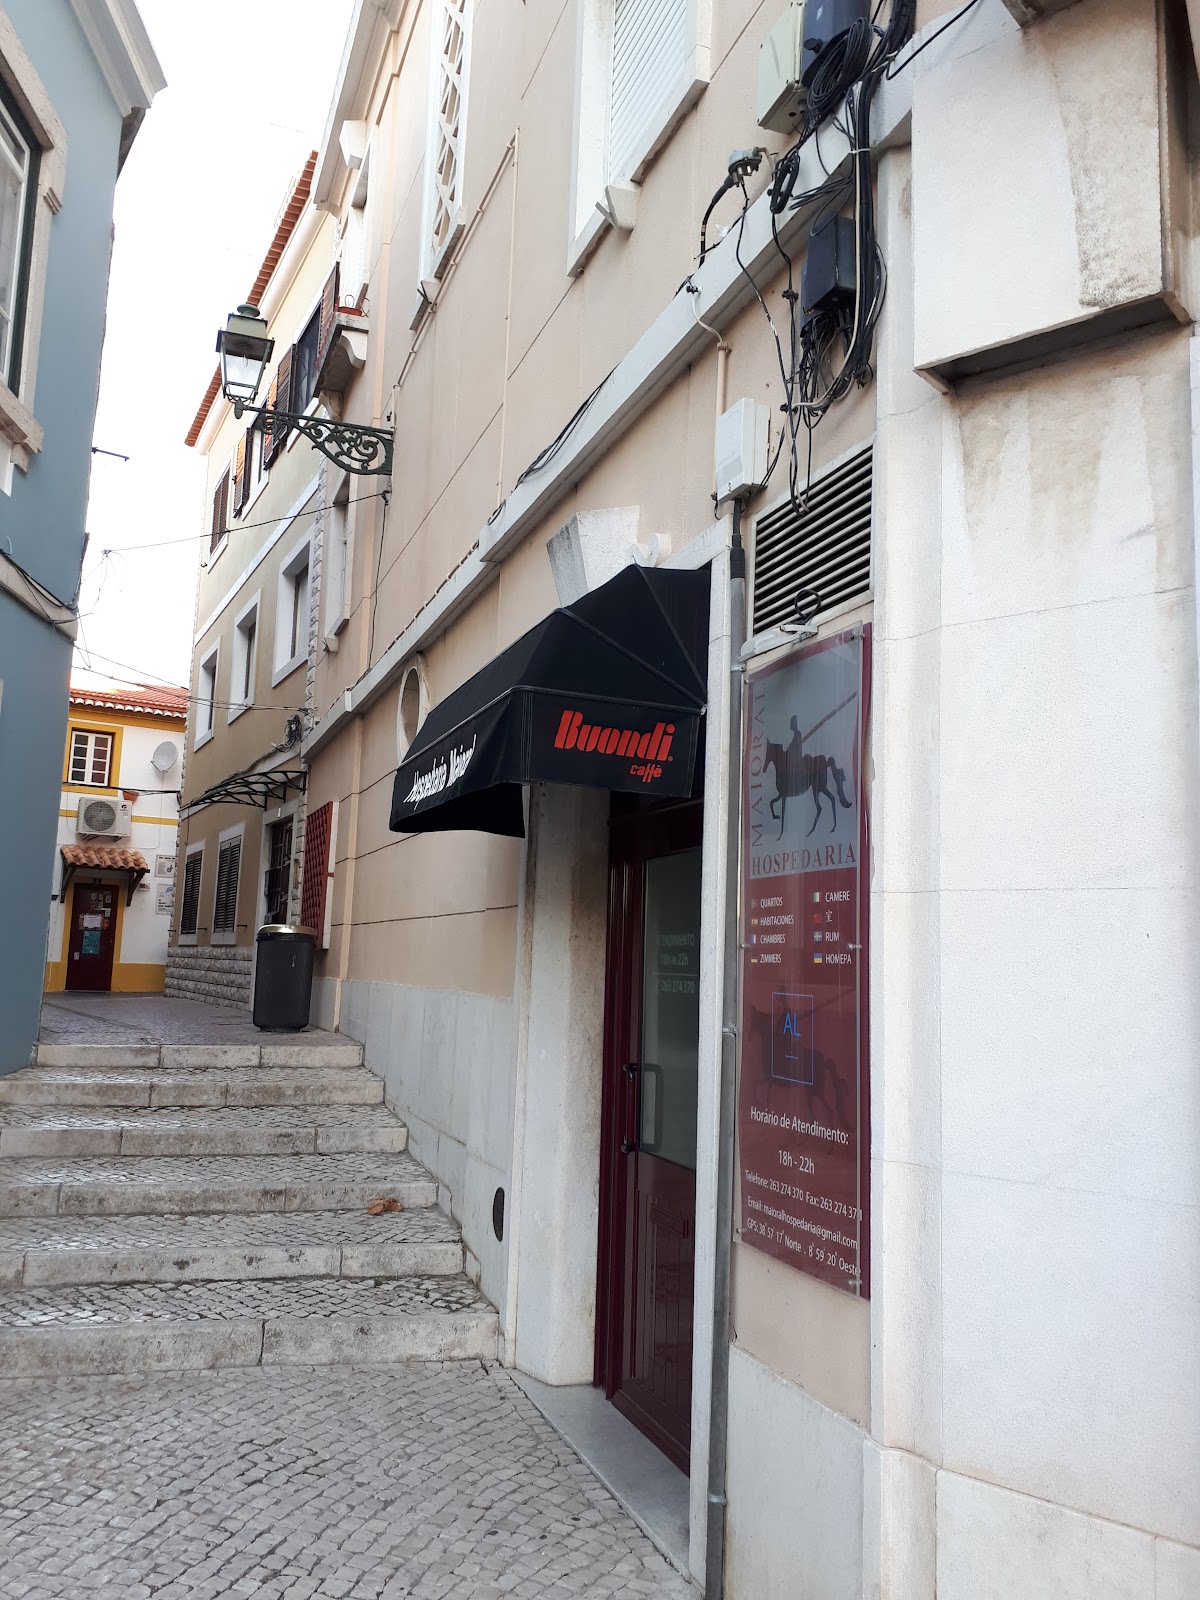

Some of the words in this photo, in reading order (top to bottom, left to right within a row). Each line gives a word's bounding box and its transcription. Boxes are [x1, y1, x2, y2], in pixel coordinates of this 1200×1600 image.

[554, 710, 676, 762] Buondi
[629, 763, 663, 783] caffè
[750, 685, 767, 847] MAIORAL
[752, 842, 857, 876] HOSPEDARIA
[760, 897, 783, 908] QUARTOS
[825, 891, 851, 902] CAMERE
[760, 915, 795, 926] HABITACIONES
[760, 934, 786, 944] CHAMBRES
[825, 931, 840, 942] RUM
[678, 952, 689, 966] 22h
[760, 954, 782, 964] ZIMMERS
[783, 1013, 801, 1037] AL
[750, 1106, 779, 1126] Horário
[780, 1113, 790, 1129] de
[791, 1116, 849, 1145] Atendimento:
[778, 1150, 793, 1168] 18h
[799, 1156, 815, 1175] 22h
[745, 1169, 769, 1188] Telefone:
[770, 1179, 780, 1192] 263
[780, 1183, 791, 1196] 274
[792, 1187, 804, 1201] 370
[806, 1191, 819, 1207] Fax:
[820, 1196, 833, 1211] 263
[834, 1201, 847, 1217] 274
[748, 1196, 763, 1212] Email:
[763, 1204, 857, 1250] maioralhospedaria@gmail.com
[747, 1218, 759, 1232] GPS:
[784, 1235, 802, 1253] Norte
[838, 1257, 861, 1277] Oeste
